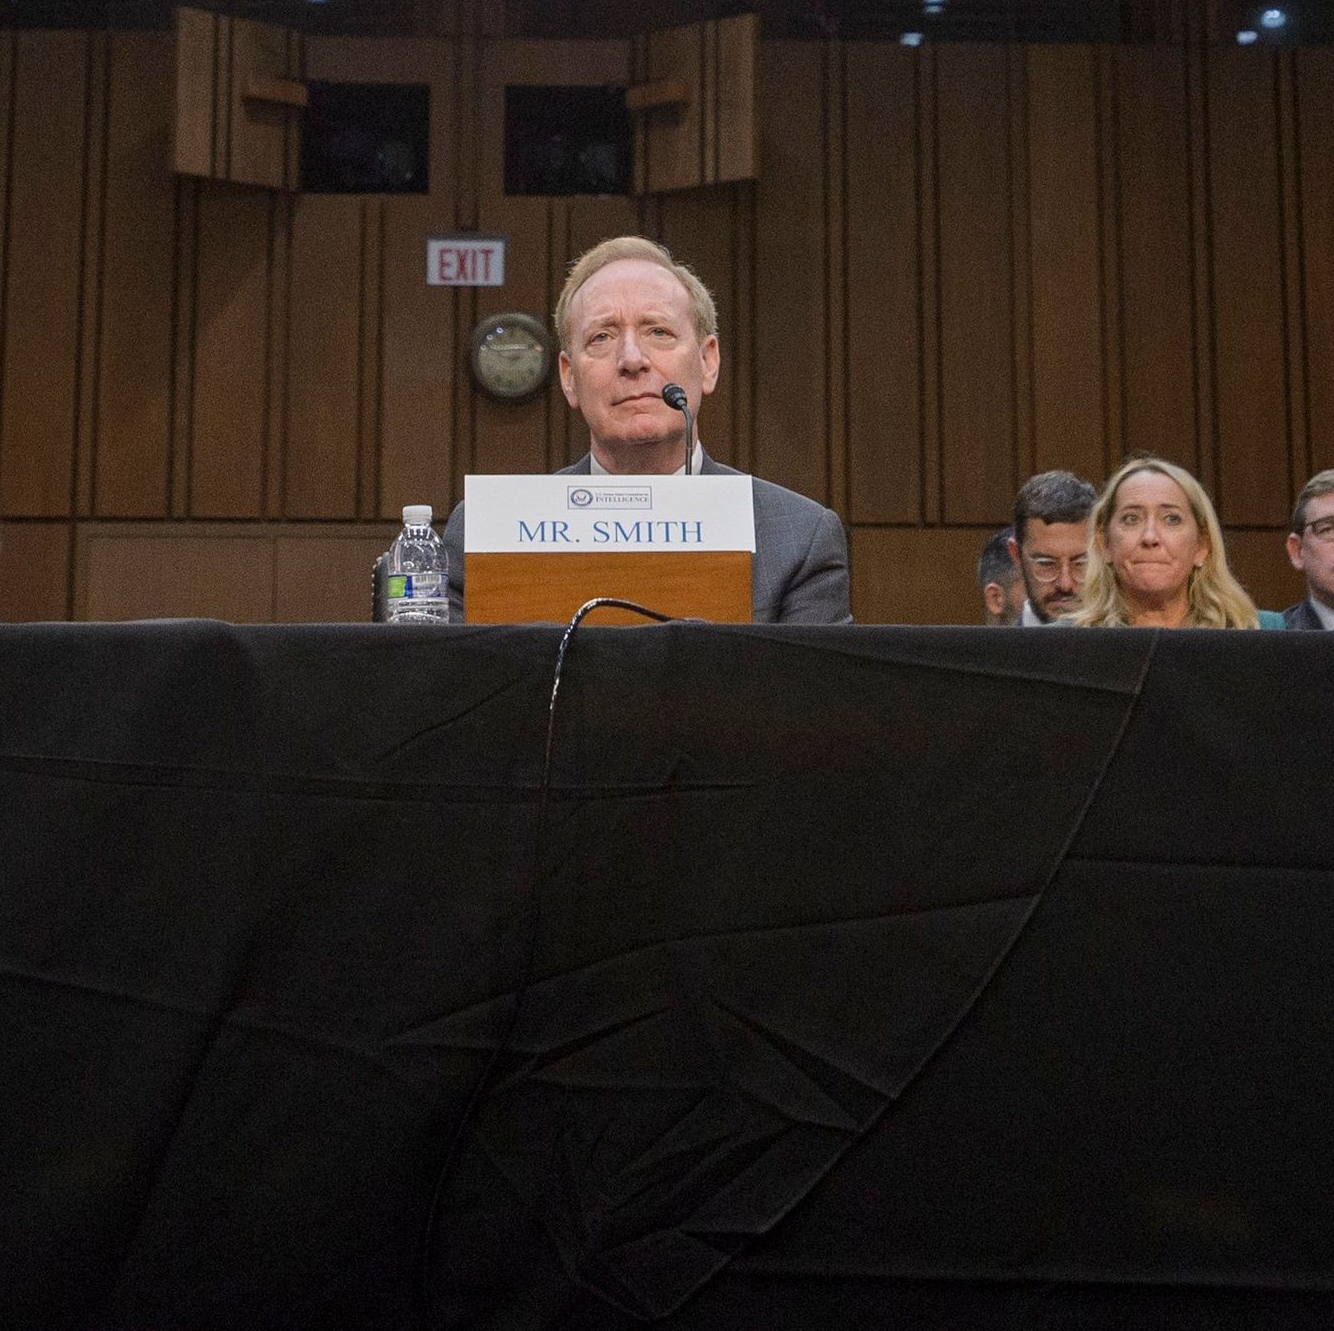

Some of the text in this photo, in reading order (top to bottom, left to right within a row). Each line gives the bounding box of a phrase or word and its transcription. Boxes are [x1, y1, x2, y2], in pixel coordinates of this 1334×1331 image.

[437, 248, 495, 281] EXIT
[517, 520, 704, 544] MR. SMITH
